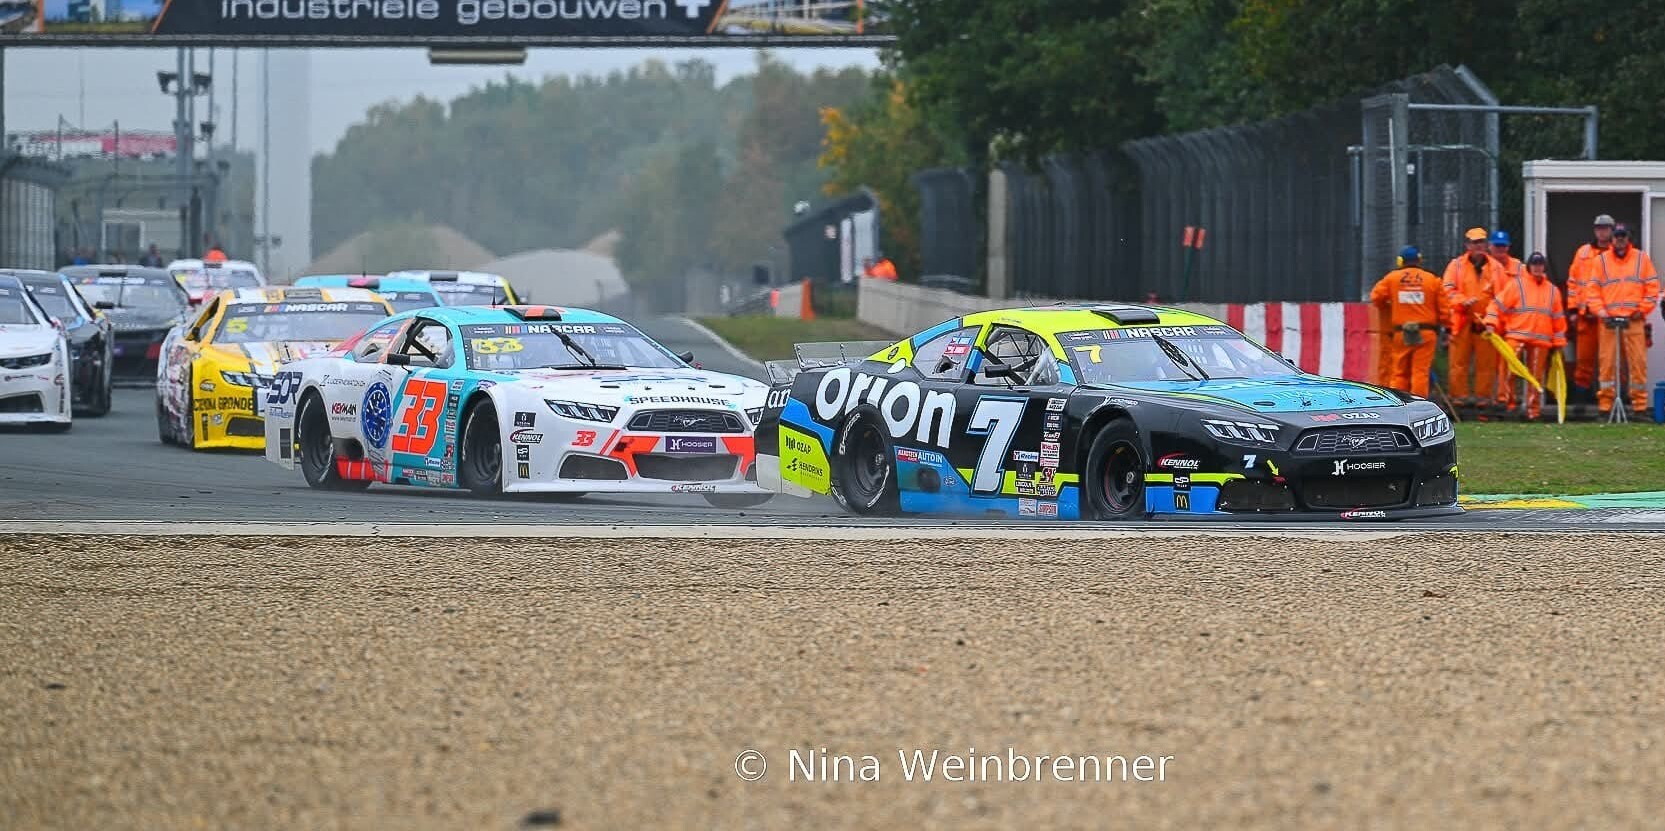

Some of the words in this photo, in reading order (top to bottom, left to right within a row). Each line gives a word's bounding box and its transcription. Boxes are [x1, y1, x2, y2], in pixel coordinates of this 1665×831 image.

[456, 0, 667, 24] gebouwen
[286, 303, 348, 312] NASCAR
[1127, 327, 1197, 338] NASCAR
[1072, 345, 1102, 363] 7
[816, 368, 957, 449] orion
[391, 379, 448, 455] 33
[512, 433, 541, 442] KENNOL
[571, 430, 597, 446] 33
[965, 395, 1030, 498] 7
[1160, 459, 1200, 467] KENNOL
[1243, 454, 1257, 469] 7
[1346, 462, 1386, 470] HOOSIER
